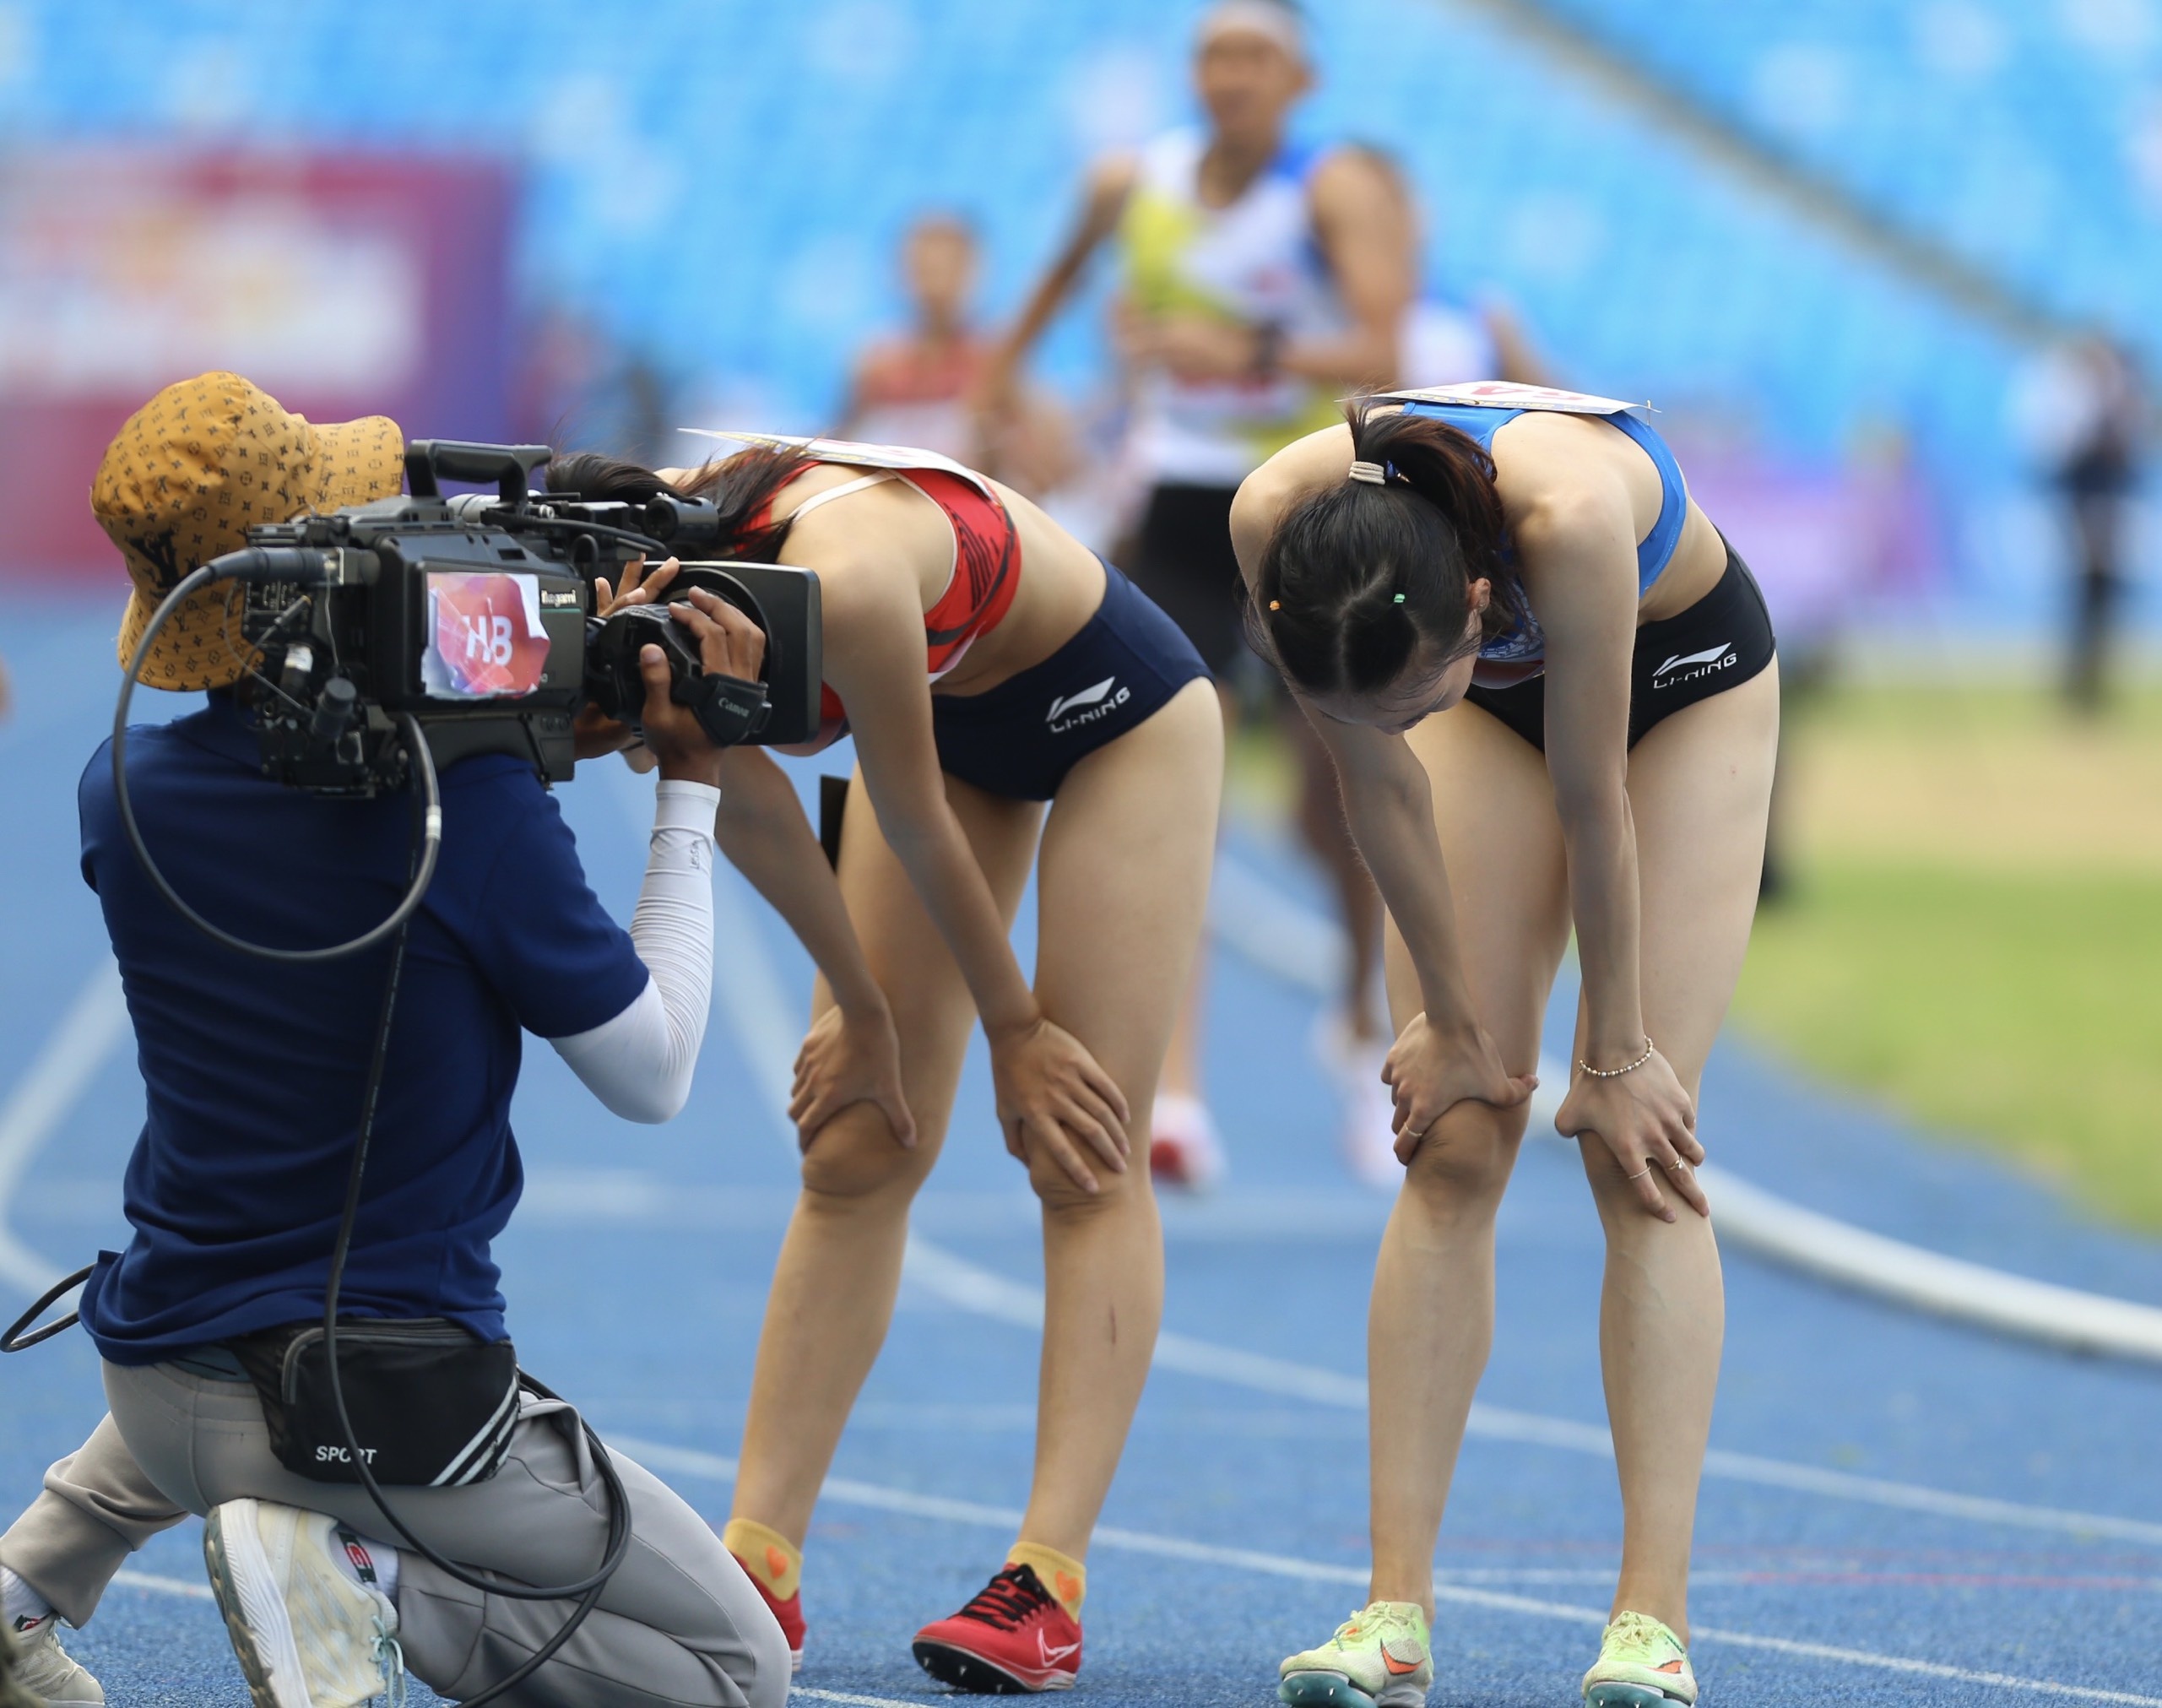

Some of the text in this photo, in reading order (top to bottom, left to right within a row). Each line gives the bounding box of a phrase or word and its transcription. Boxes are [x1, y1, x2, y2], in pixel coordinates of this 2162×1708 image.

[1653, 652, 1738, 690] LI-NING
[718, 697, 750, 718] Canon
[1049, 686, 1131, 734] LI-NING
